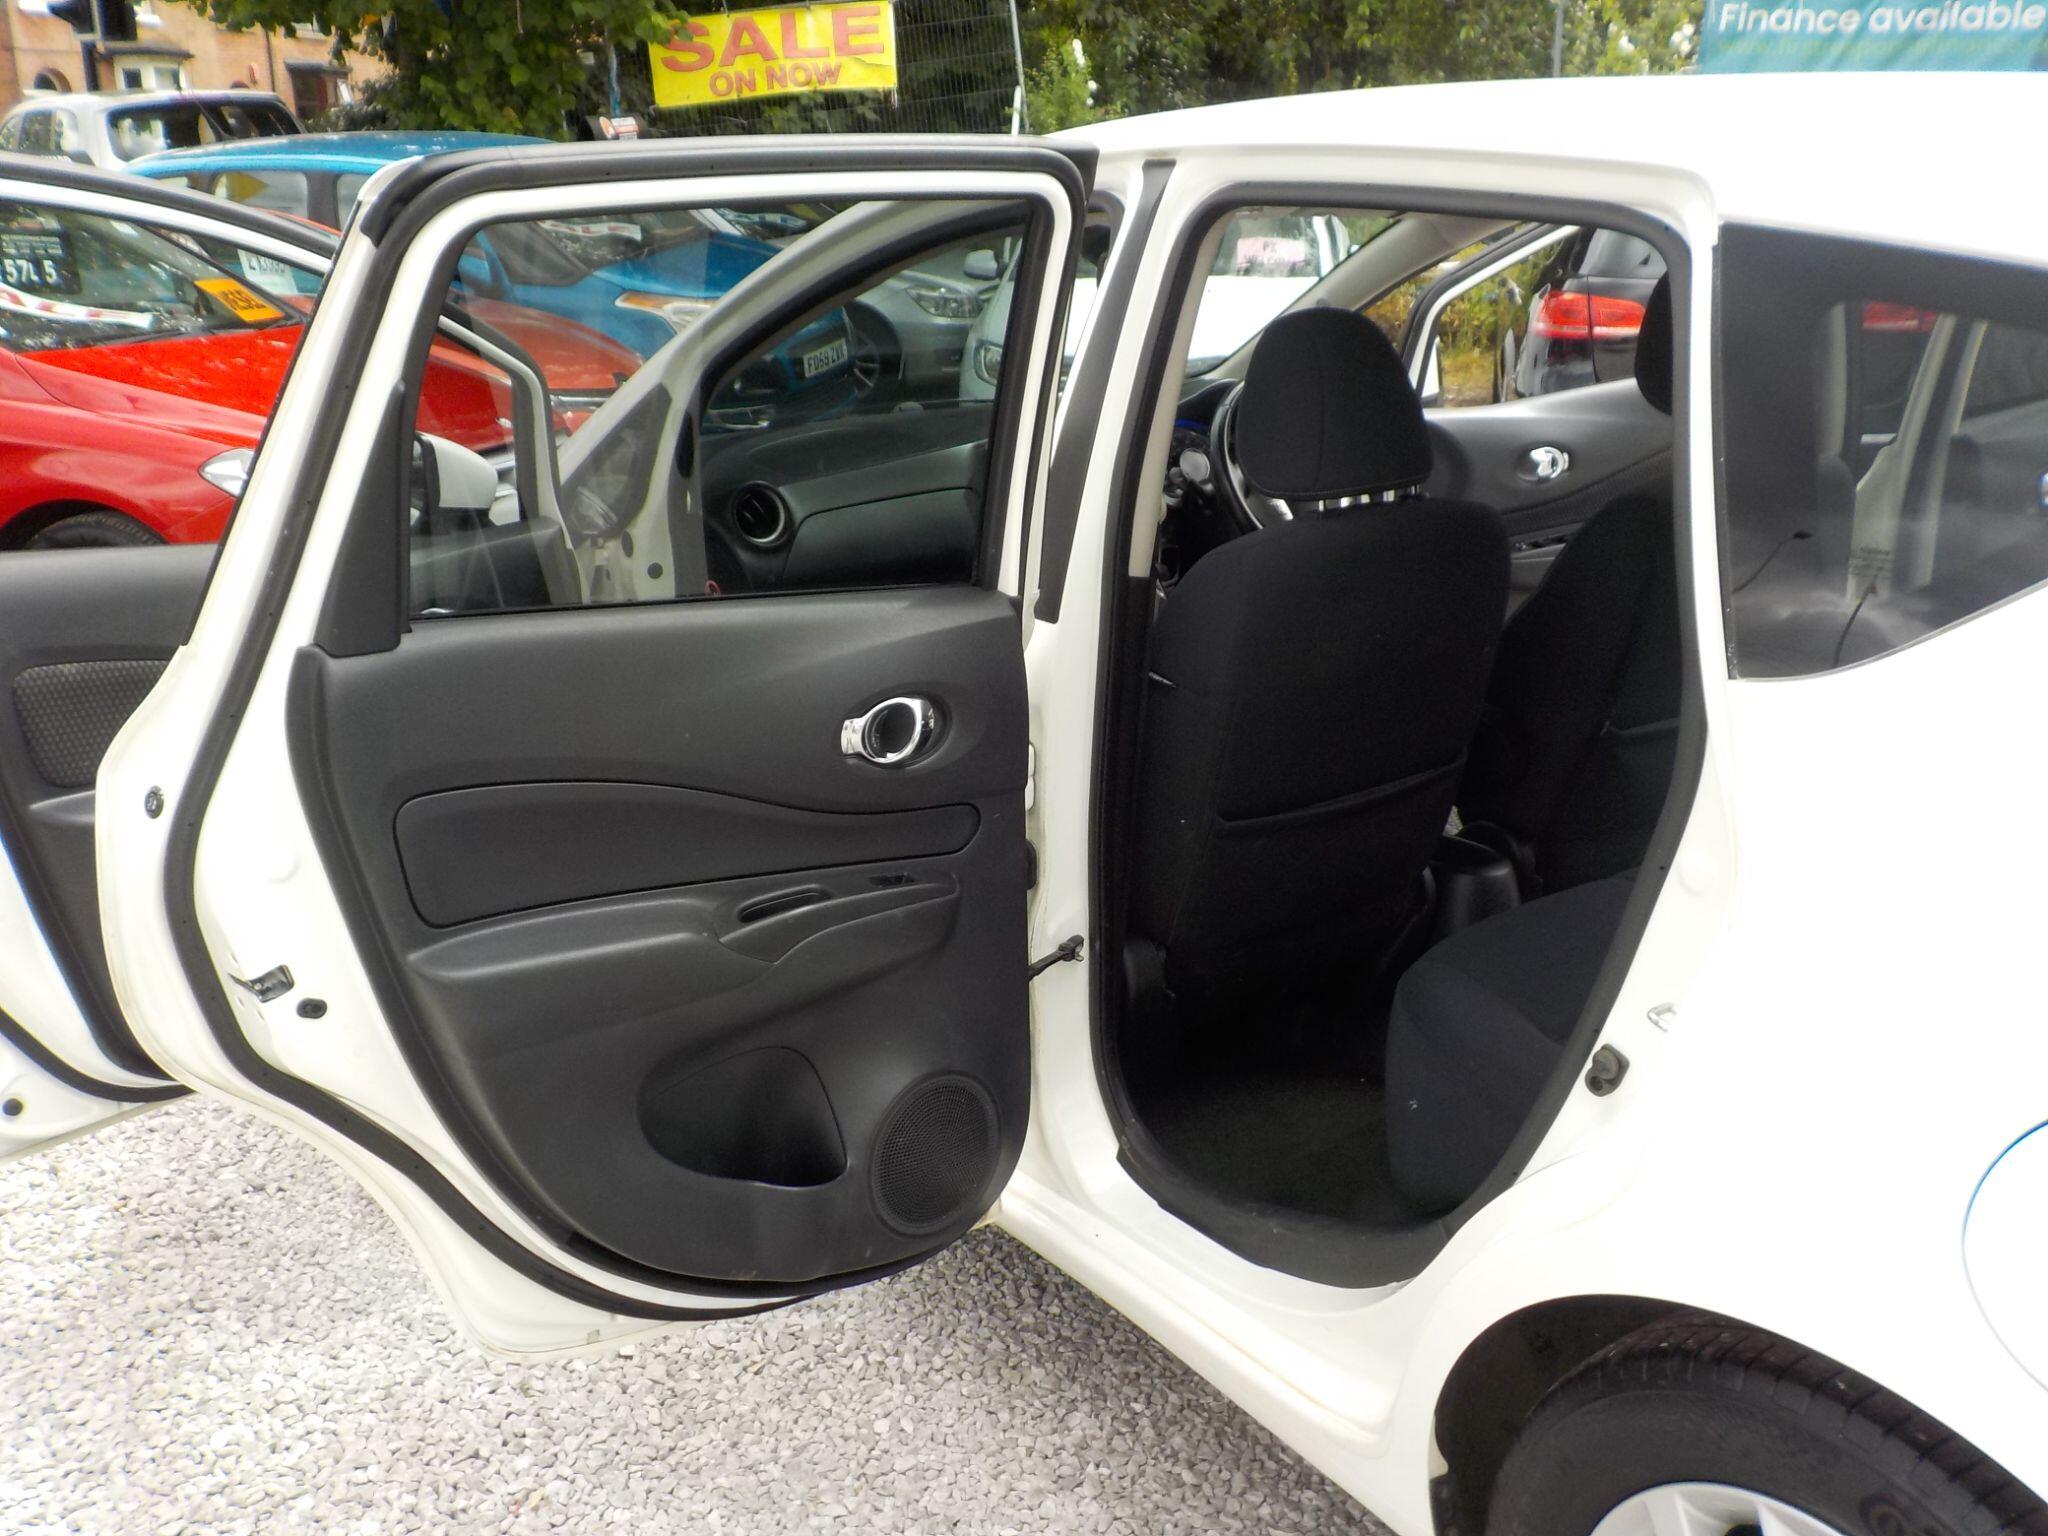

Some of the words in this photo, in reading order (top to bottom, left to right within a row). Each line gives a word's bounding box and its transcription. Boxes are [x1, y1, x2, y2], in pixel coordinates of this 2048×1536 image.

[1719, 2, 1861, 33] Finance
[1868, 0, 2047, 32] available
[661, 6, 884, 72] SALE
[709, 69, 757, 96] ON
[766, 62, 841, 91] NOW
